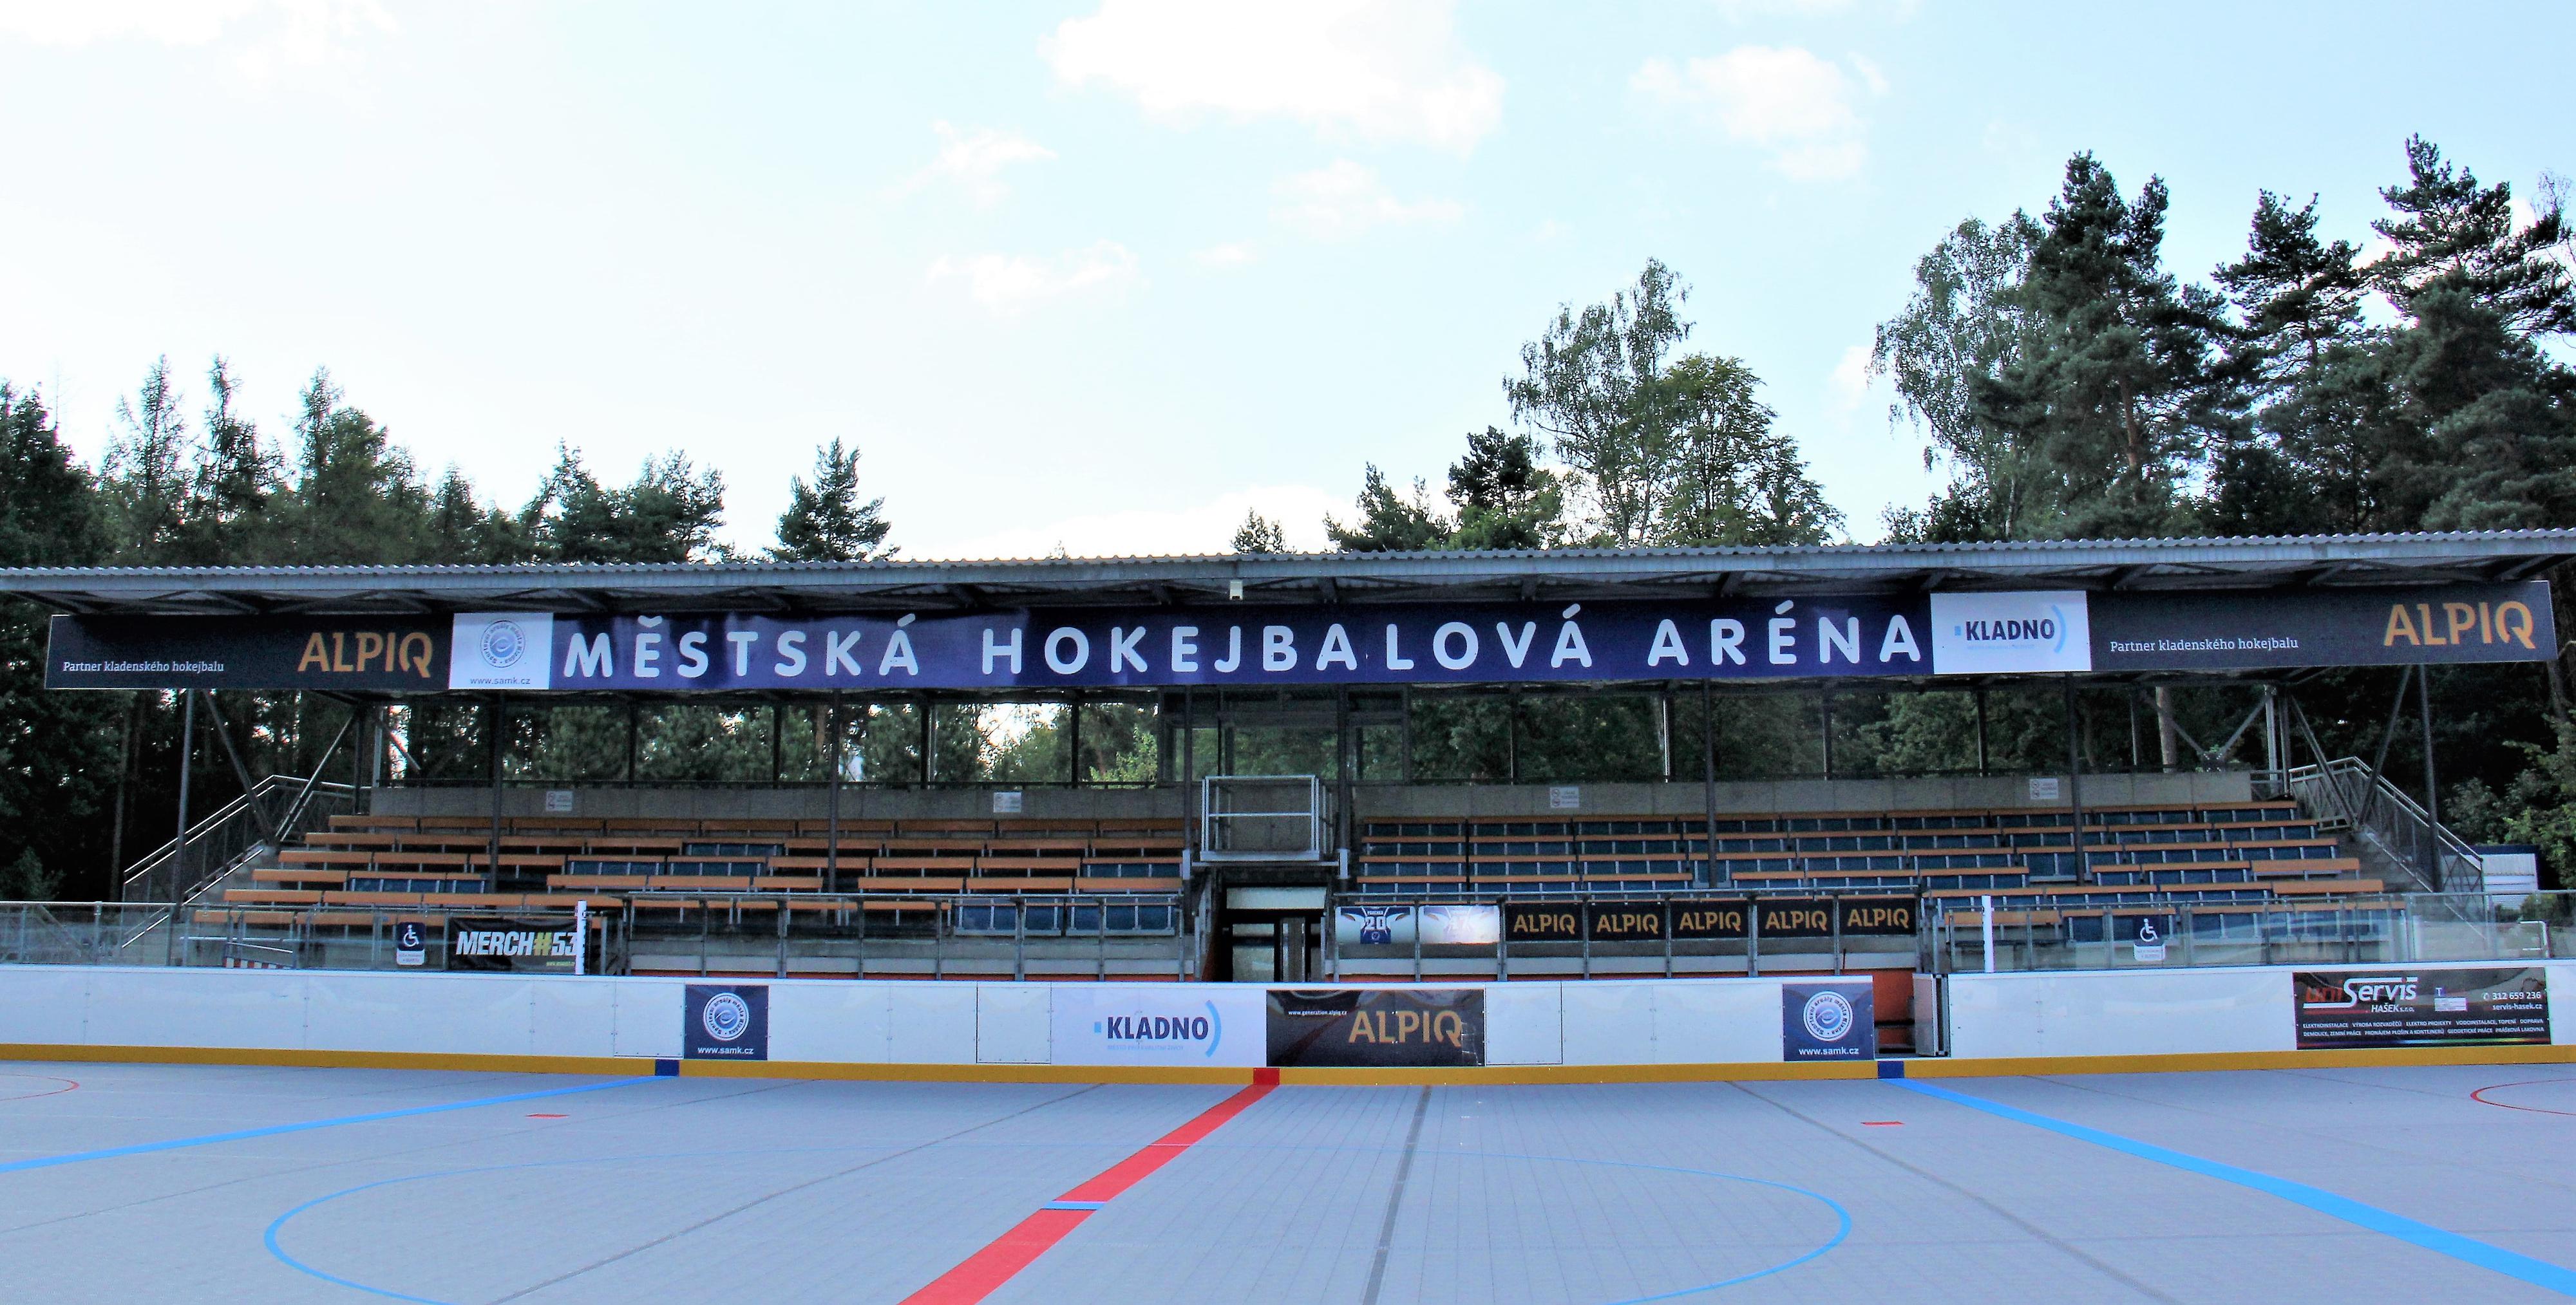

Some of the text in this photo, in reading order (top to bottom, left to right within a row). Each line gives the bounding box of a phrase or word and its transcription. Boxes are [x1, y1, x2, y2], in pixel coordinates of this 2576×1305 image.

[1965, 619, 2055, 641] KLADNO
[2383, 601, 2536, 649] ALPIQ
[564, 599, 1921, 678] MĚSTSKÁ HOKEJBALOVÁ ARÉNA
[2110, 637, 2298, 652] Partner kladenského hokejbalu
[298, 632, 433, 679] ALPIQ
[63, 661, 224, 673] Partner kladenského hokejbalu
[1363, 916, 1386, 930] 20
[1513, 914, 1576, 934] ALPIQ
[1596, 914, 1658, 934] ALPIQ
[1679, 912, 1741, 932] ALPIQ
[1765, 910, 1827, 931] ALPIQ
[1848, 908, 1909, 929] ALPIQ
[2509, 991, 2524, 1000] 659
[2371, 1003, 2399, 1013] HAŠEK
[1108, 1017, 1209, 1040] KLADNO
[1349, 1010, 1463, 1047] ALPIQ
